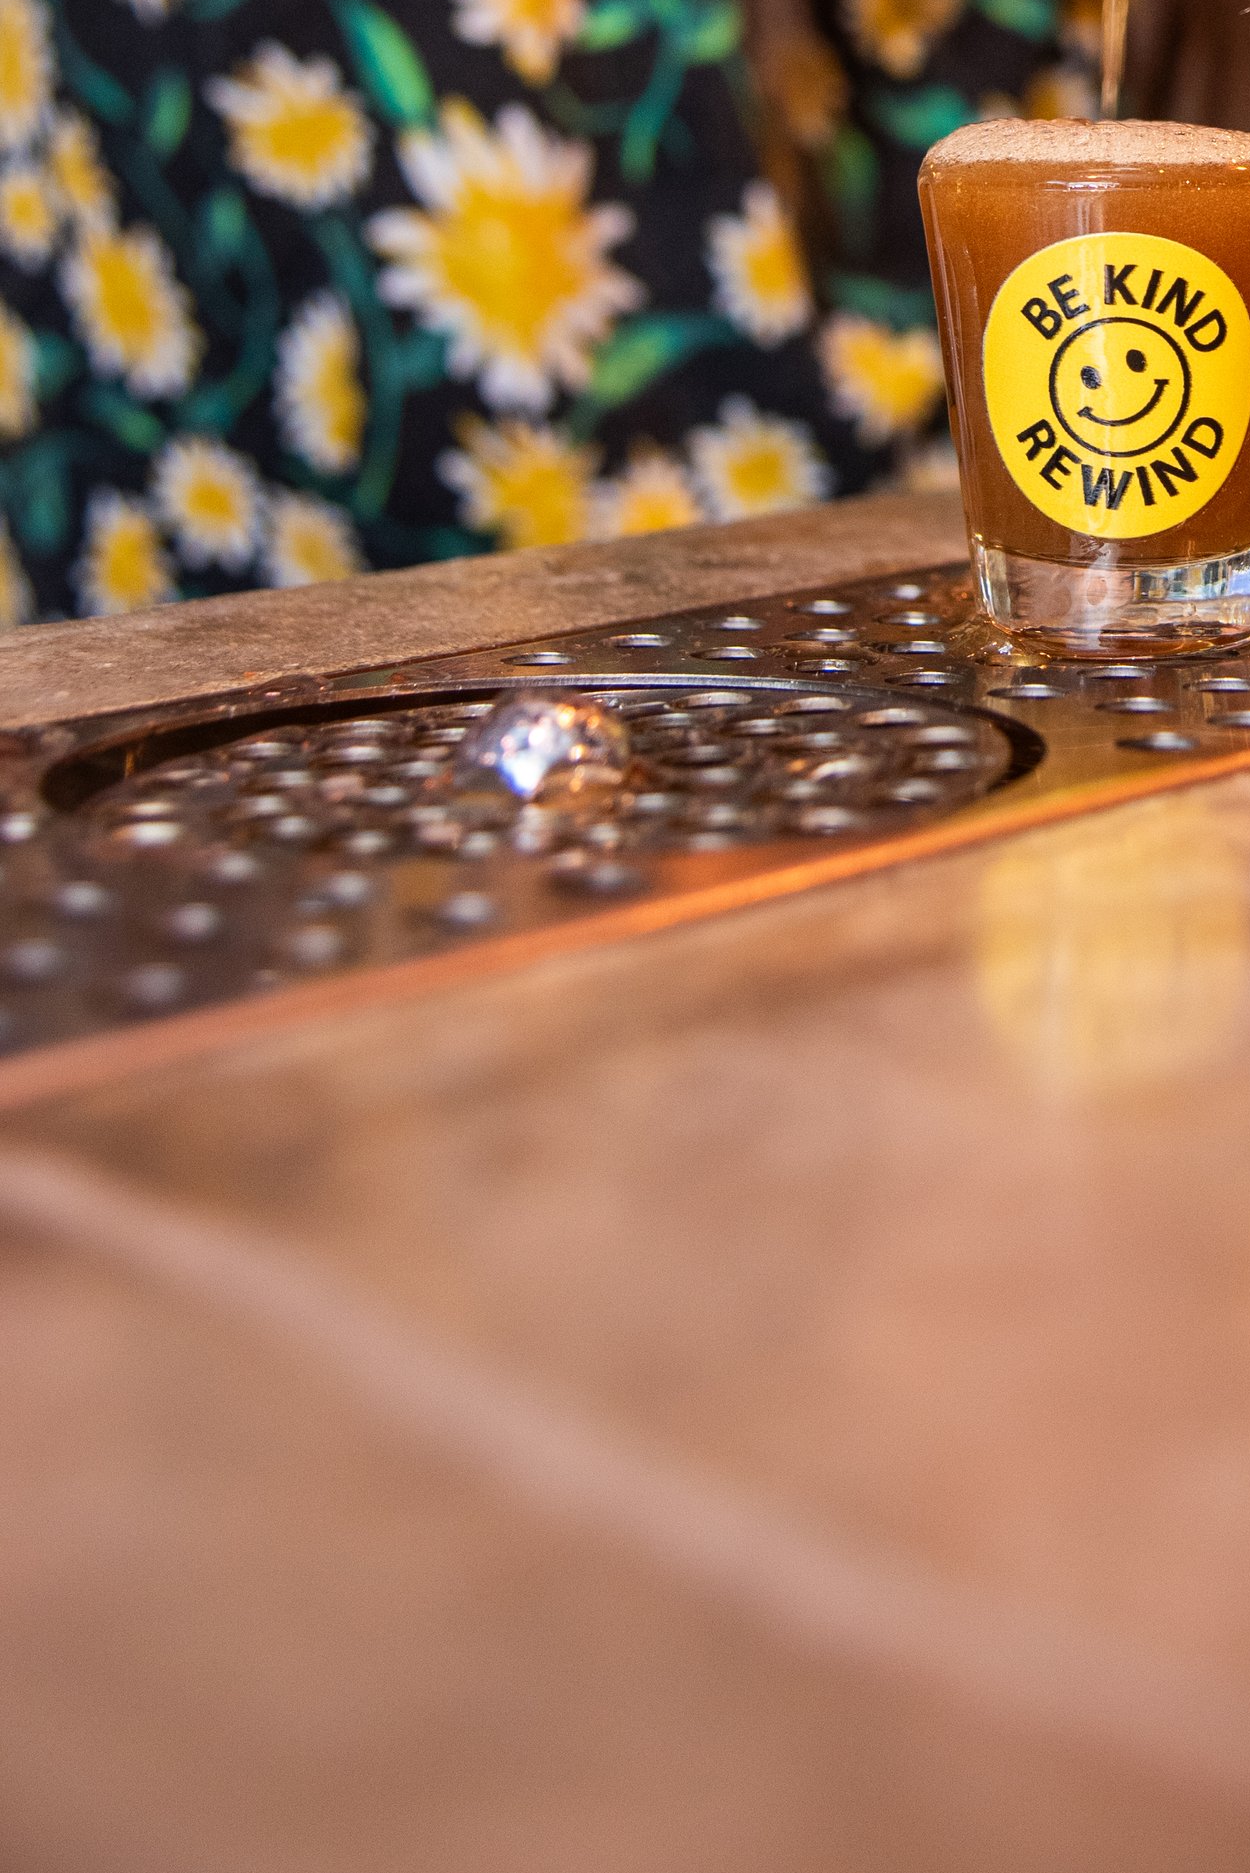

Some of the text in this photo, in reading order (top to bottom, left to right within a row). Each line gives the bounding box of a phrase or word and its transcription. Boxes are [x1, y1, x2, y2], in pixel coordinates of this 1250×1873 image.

[1020, 264, 1228, 353] BE KIND
[1016, 416, 1225, 510] REWIND
